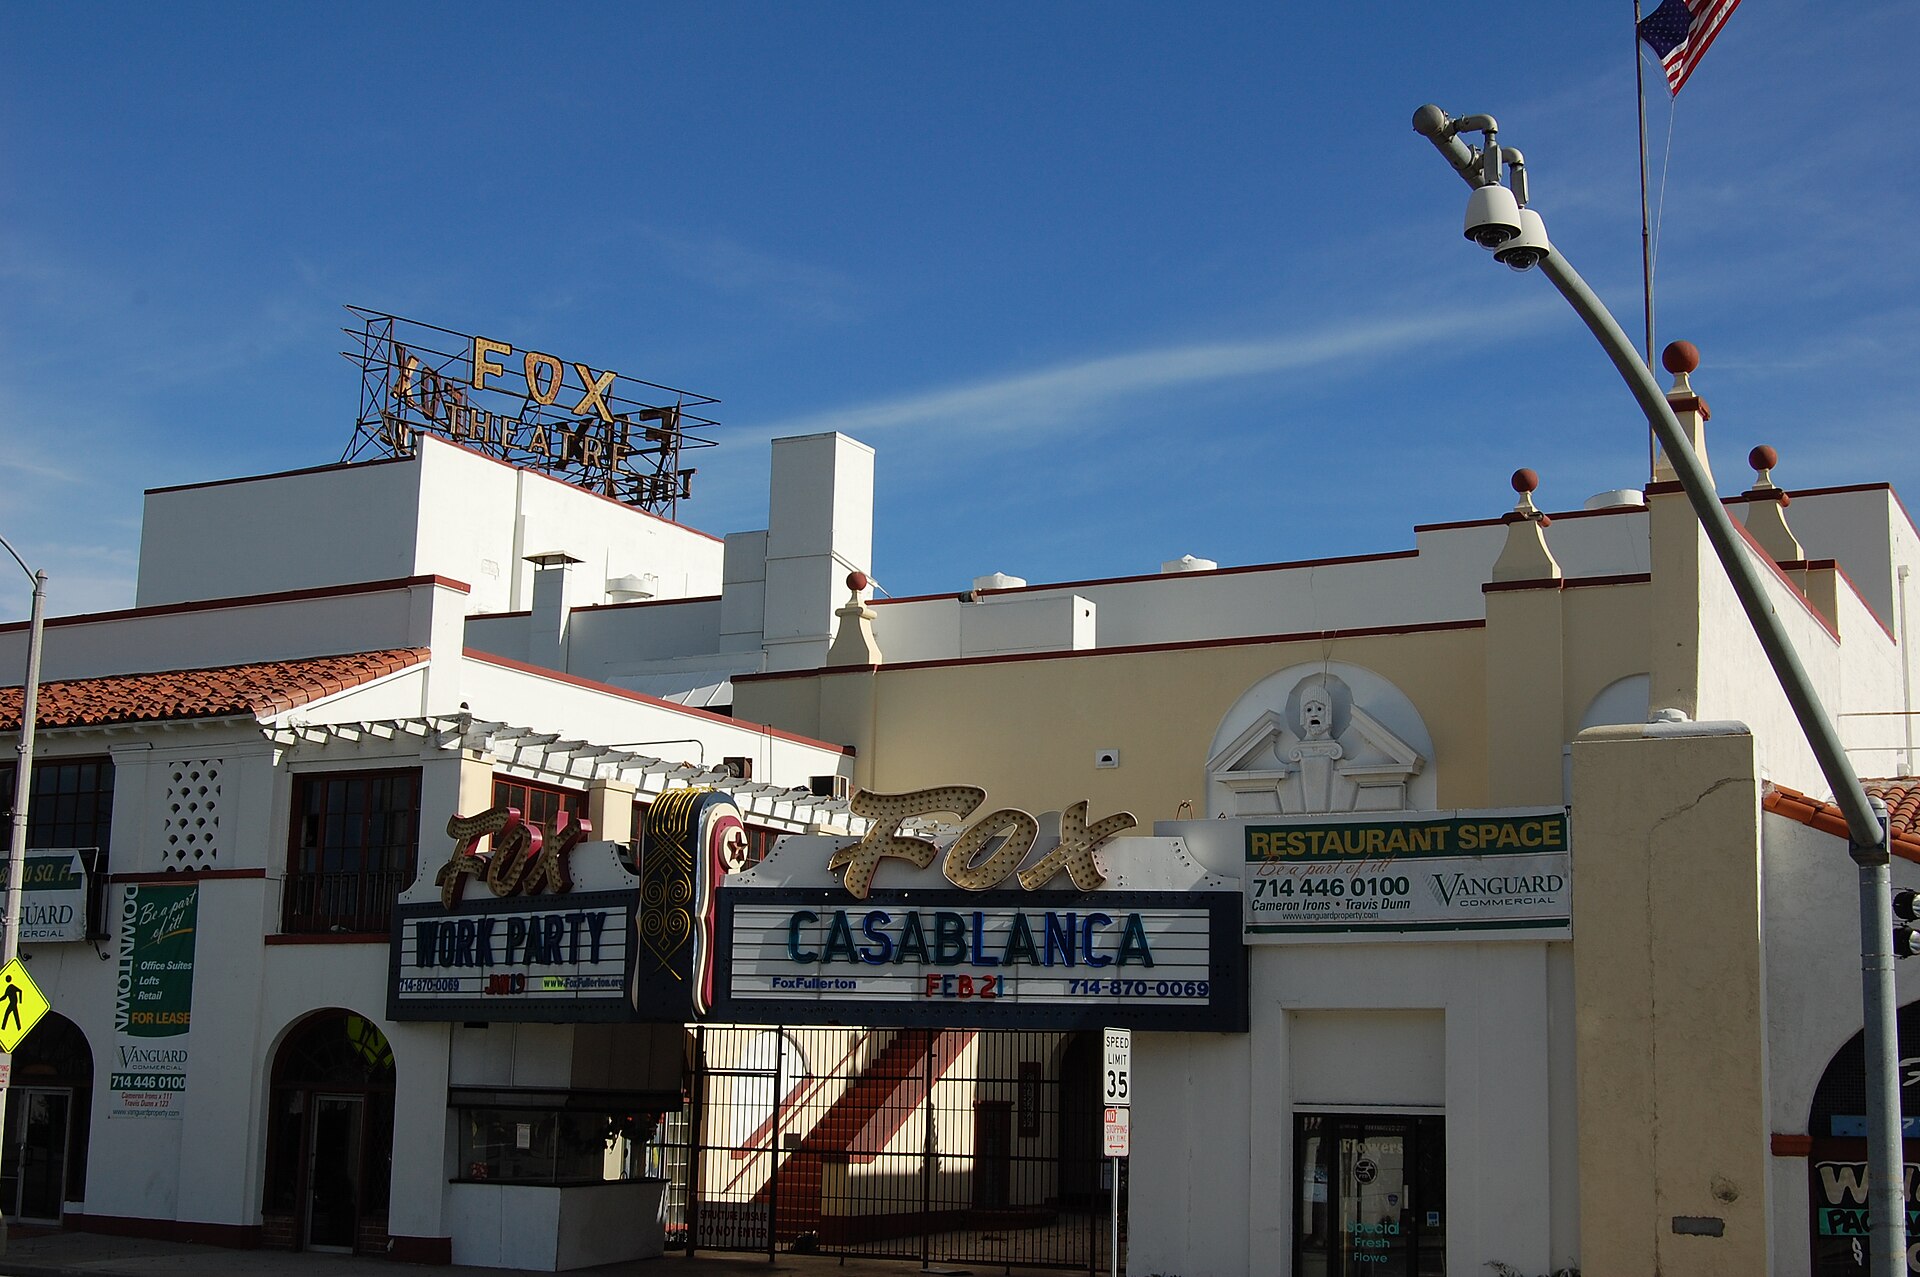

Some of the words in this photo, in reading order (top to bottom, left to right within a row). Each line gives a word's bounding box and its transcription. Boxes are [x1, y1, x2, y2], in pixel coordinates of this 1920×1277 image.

[472, 336, 618, 423] FOX
[444, 401, 631, 475] THEATRE
[1250, 826, 1450, 855] RESTAURANT
[1457, 820, 1561, 849] SPACE
[1256, 854, 1283, 876] Be
[1288, 867, 1299, 875] a
[1300, 858, 1344, 881] part
[1253, 879, 1294, 897] 714
[1300, 878, 1345, 896] 446
[1350, 876, 1410, 896] 0100
[1432, 873, 1563, 906] VANGUARD
[139, 902, 158, 925] Be
[160, 907, 168, 917] a
[169, 889, 197, 919] part
[1252, 899, 1299, 911] Cameron
[1303, 899, 1330, 910] Irons
[1345, 899, 1378, 910] Travis
[1381, 898, 1410, 909] Dunn
[1460, 897, 1555, 907] COMMERCIAL
[1282, 912, 1379, 921] www.vanguardproperty.com
[416, 916, 496, 968] WORK
[504, 912, 606, 966] PARTY
[788, 910, 1154, 968] CASABLANCA
[114, 885, 139, 1033] DOWNTOWN
[141, 961, 165, 970] Office
[167, 961, 192, 970] Suites
[139, 976, 160, 985] Lofts
[400, 979, 459, 991] 714-870-0069
[772, 977, 857, 990] FoxFullerton
[925, 974, 975, 998] FEB
[980, 974, 1003, 999] 21
[1069, 980, 1209, 996] 714-870-0069
[138, 991, 162, 1000] Retail
[131, 1012, 154, 1024] FOR
[156, 1012, 190, 1024] LEASE
[1106, 1036, 1129, 1049] SPEED
[119, 1046, 188, 1068] VANGUARD
[1108, 1054, 1127, 1065] LIMIT
[112, 1076, 131, 1088] 714
[134, 1076, 156, 1088] 446
[158, 1076, 185, 1088] 0100
[1107, 1070, 1128, 1098] 35
[1106, 1110, 1115, 1122] NO
[1106, 1125, 1127, 1133] STOPPING
[699, 1226, 713, 1235] DO
[1345, 1221, 1400, 1236] Special
[1354, 1237, 1390, 1248] Fresh
